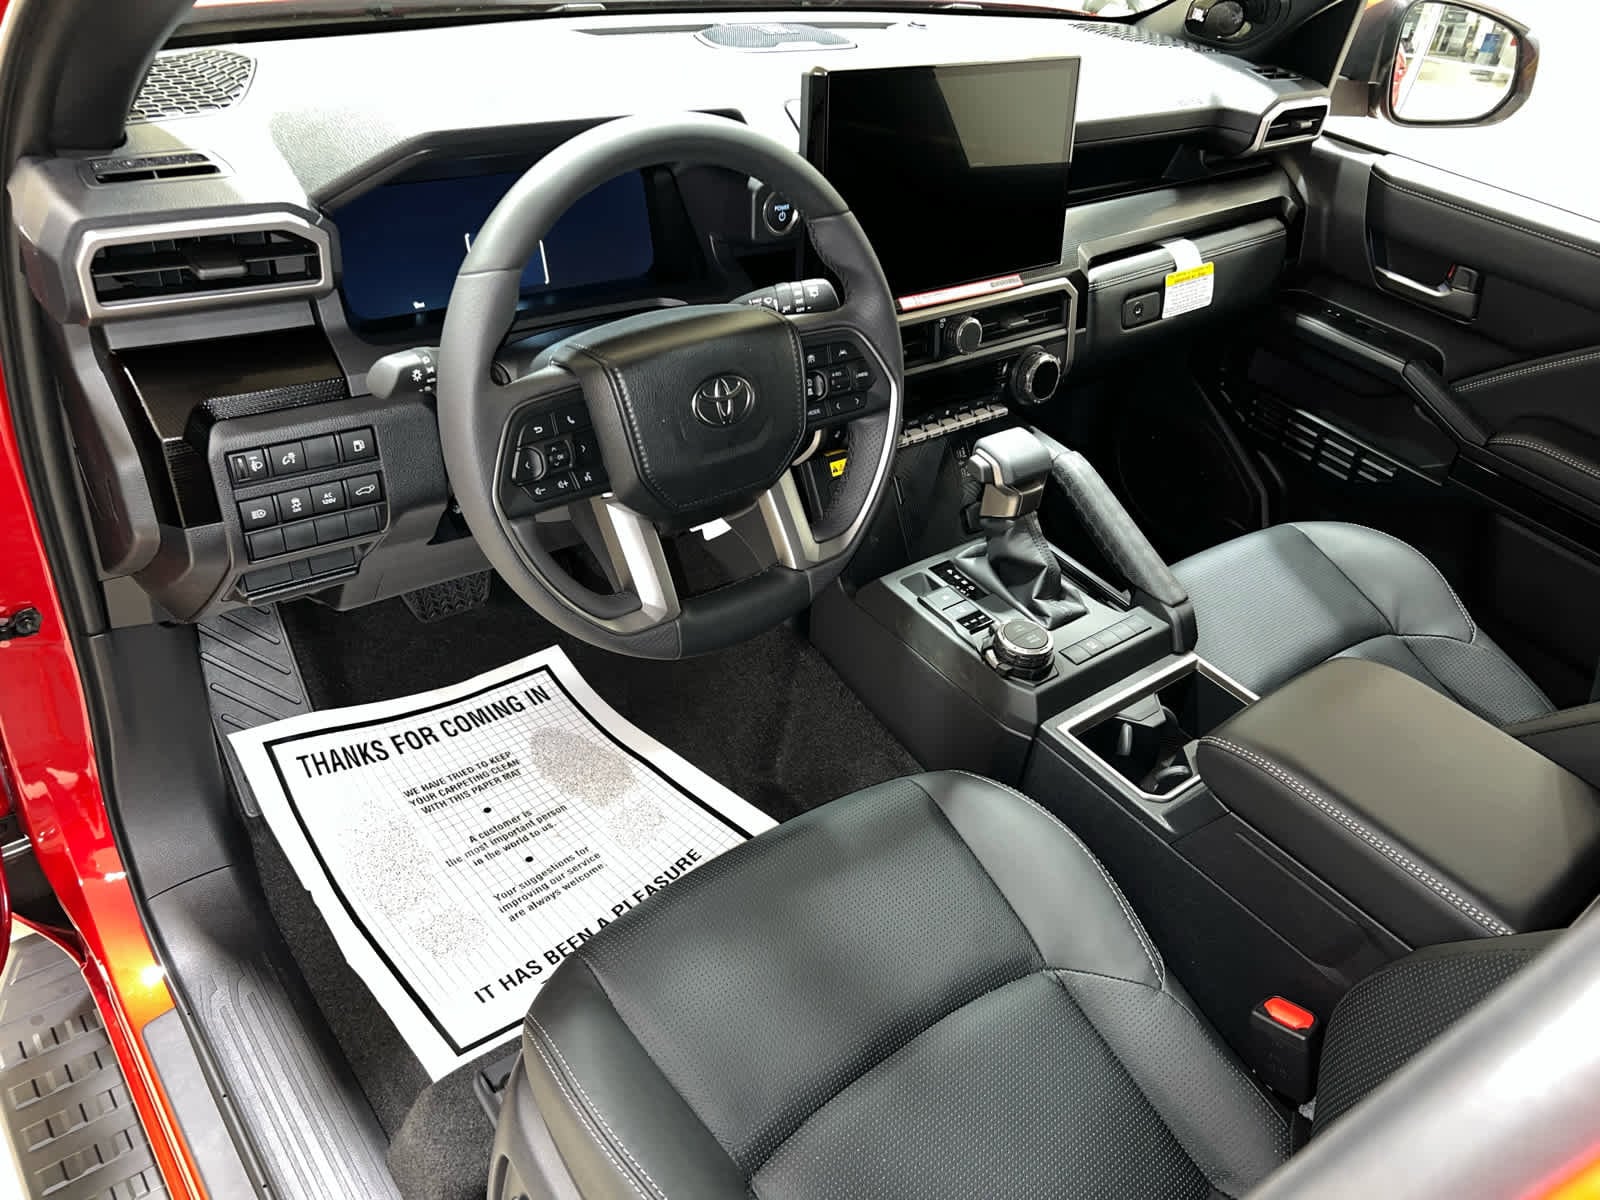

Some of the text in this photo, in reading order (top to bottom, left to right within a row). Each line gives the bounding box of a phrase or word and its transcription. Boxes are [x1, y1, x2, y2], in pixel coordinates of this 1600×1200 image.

[296, 685, 551, 778] THANKS FOR COMING IN
[403, 751, 512, 799] WE HAVE TRIED TO KEEP
[408, 758, 520, 807] YOUR CARPETING CLEAN
[421, 768, 522, 815] WITH THIS PAPER MAT
[445, 804, 568, 868] the most important person
[469, 809, 532, 844] A customer is
[473, 822, 557, 867] in the world to us.
[493, 845, 590, 902] Your suggestions for
[499, 852, 601, 914] improving our service
[508, 862, 608, 923] are always welcome.
[474, 984, 495, 1003] IT
[498, 960, 543, 991] HAS
[543, 927, 595, 966] BEEN
[597, 917, 610, 929] A
